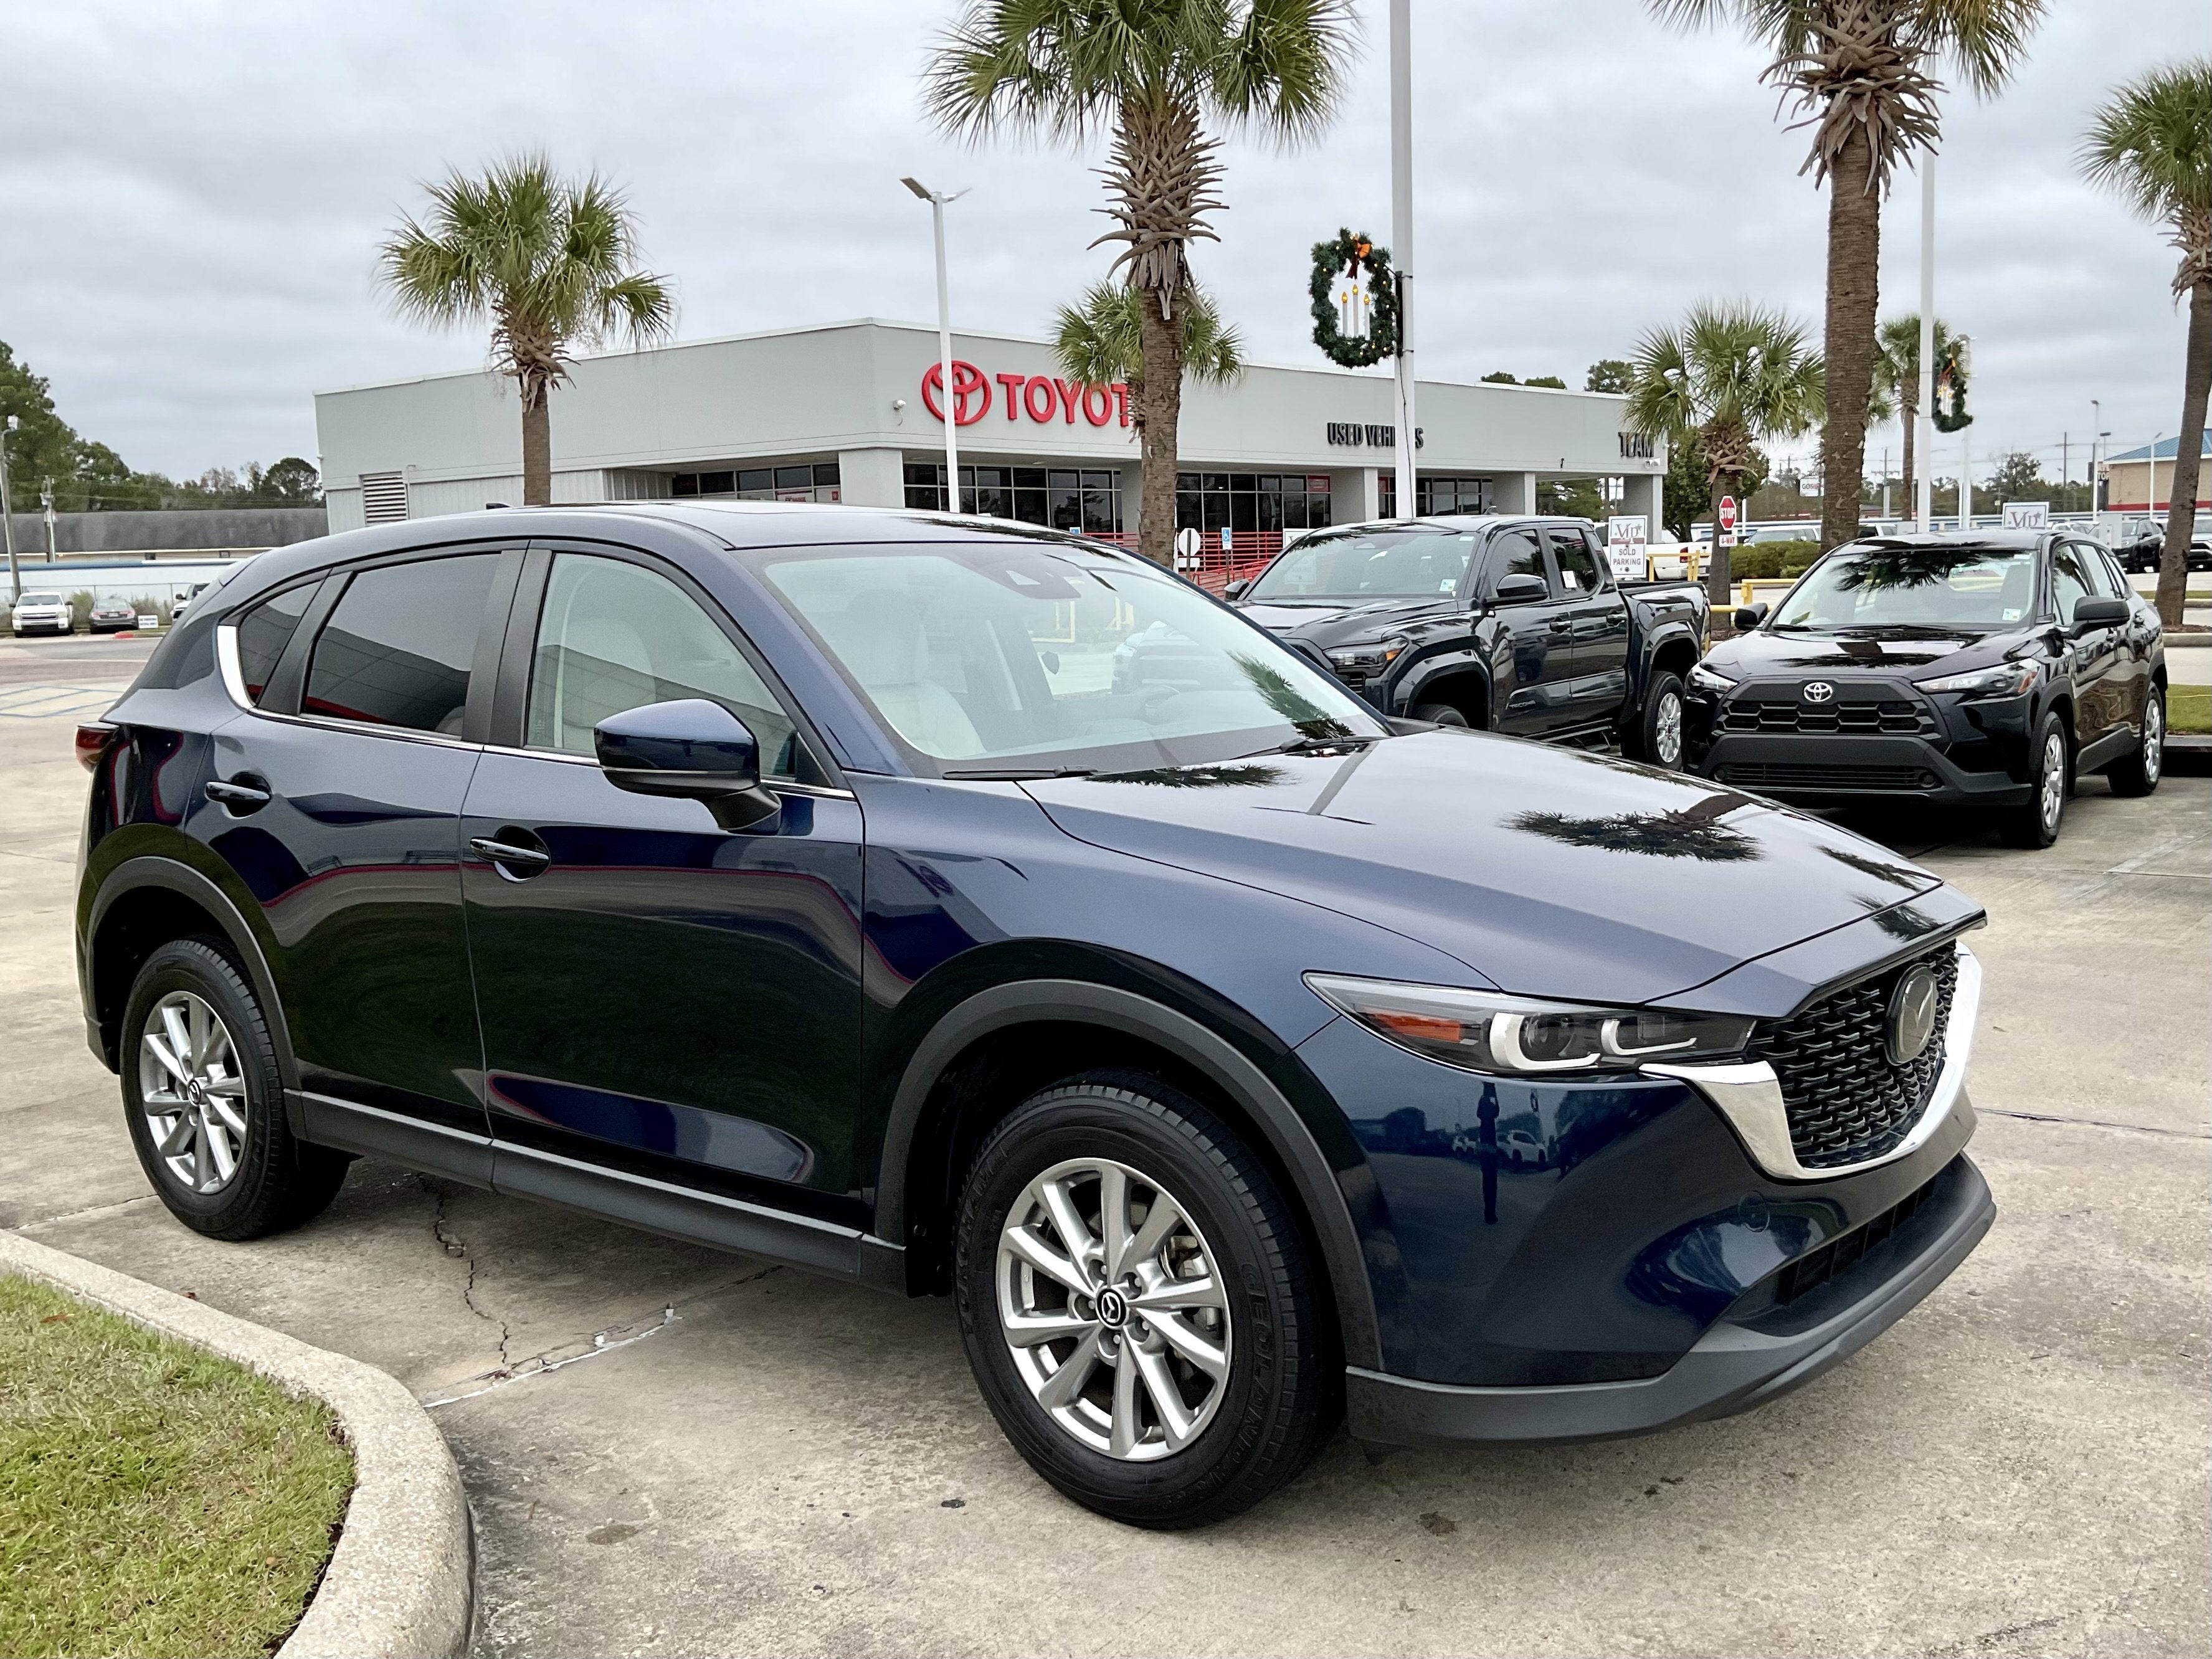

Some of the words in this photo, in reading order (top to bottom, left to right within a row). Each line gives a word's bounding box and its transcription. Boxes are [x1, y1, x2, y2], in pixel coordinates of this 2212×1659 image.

[997, 373, 1138, 427] TOYOT
[1327, 422, 1364, 446] USED
[1364, 424, 1424, 449] VEHIS
[1618, 431, 1654, 458] TEAM
[1721, 507, 1735, 519] STOP
